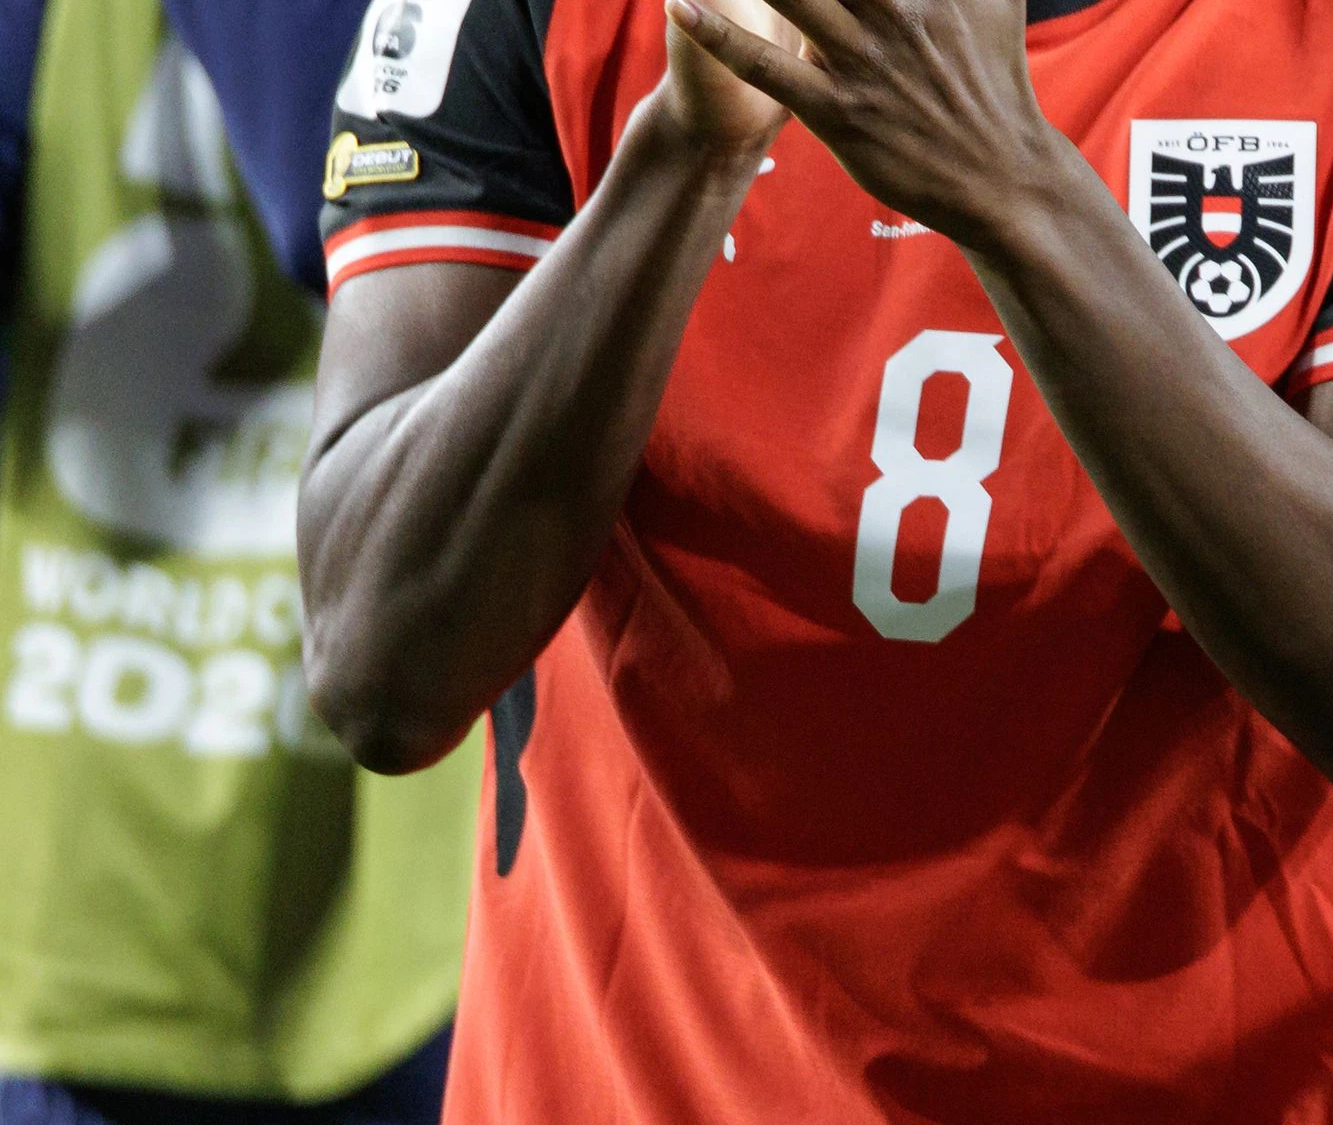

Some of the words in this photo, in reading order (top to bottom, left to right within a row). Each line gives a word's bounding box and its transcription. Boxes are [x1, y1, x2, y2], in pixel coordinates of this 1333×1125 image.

[1186, 131, 1261, 152] ÖFB
[852, 329, 1014, 643] 8
[20, 543, 249, 645] WORLD
[8, 619, 312, 753] 202
